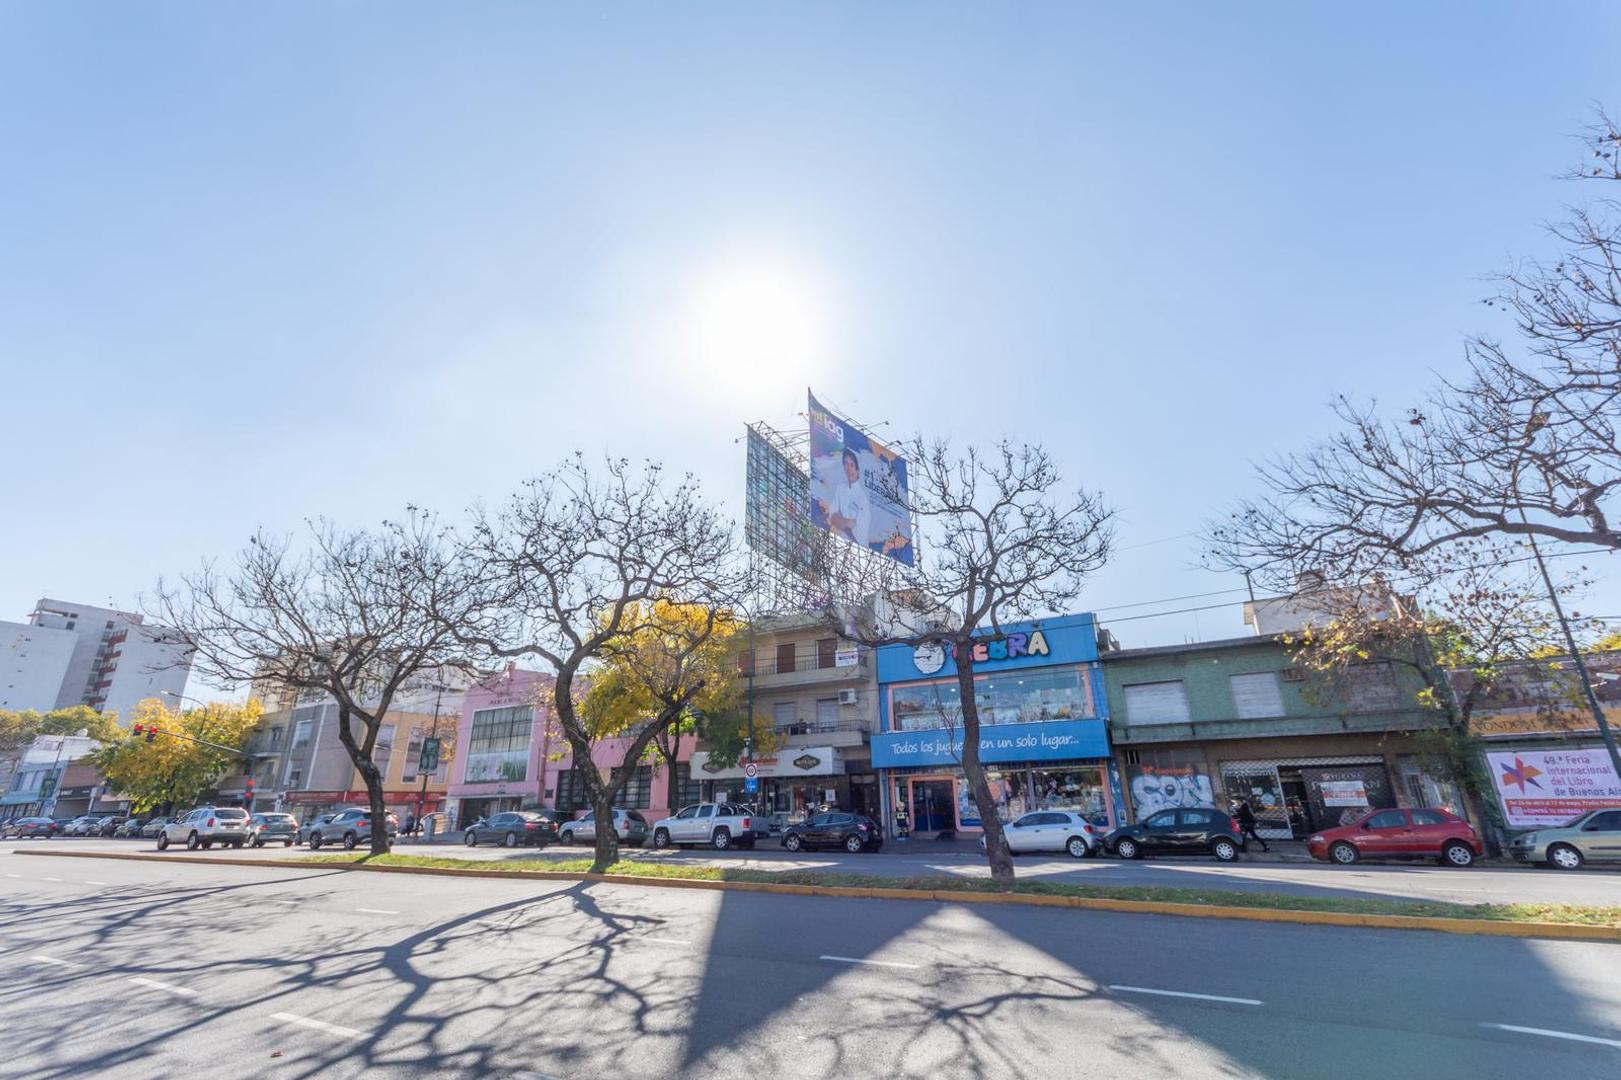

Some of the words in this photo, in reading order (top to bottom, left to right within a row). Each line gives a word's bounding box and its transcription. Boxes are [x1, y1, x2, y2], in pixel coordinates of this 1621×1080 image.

[951, 631, 1049, 663] EBRA
[890, 743, 918, 755] Todos
[920, 742, 934, 753] los
[935, 739, 963, 756] jugue
[981, 739, 994, 749] en
[997, 739, 1014, 748] un
[1016, 735, 1037, 748] solo
[1566, 755, 1590, 764] Feria
[1546, 766, 1611, 776] Internacional
[1551, 777, 1567, 785] del
[1568, 777, 1593, 785] Libro
[1554, 787, 1566, 796] de
[1568, 787, 1605, 796] Buenos
